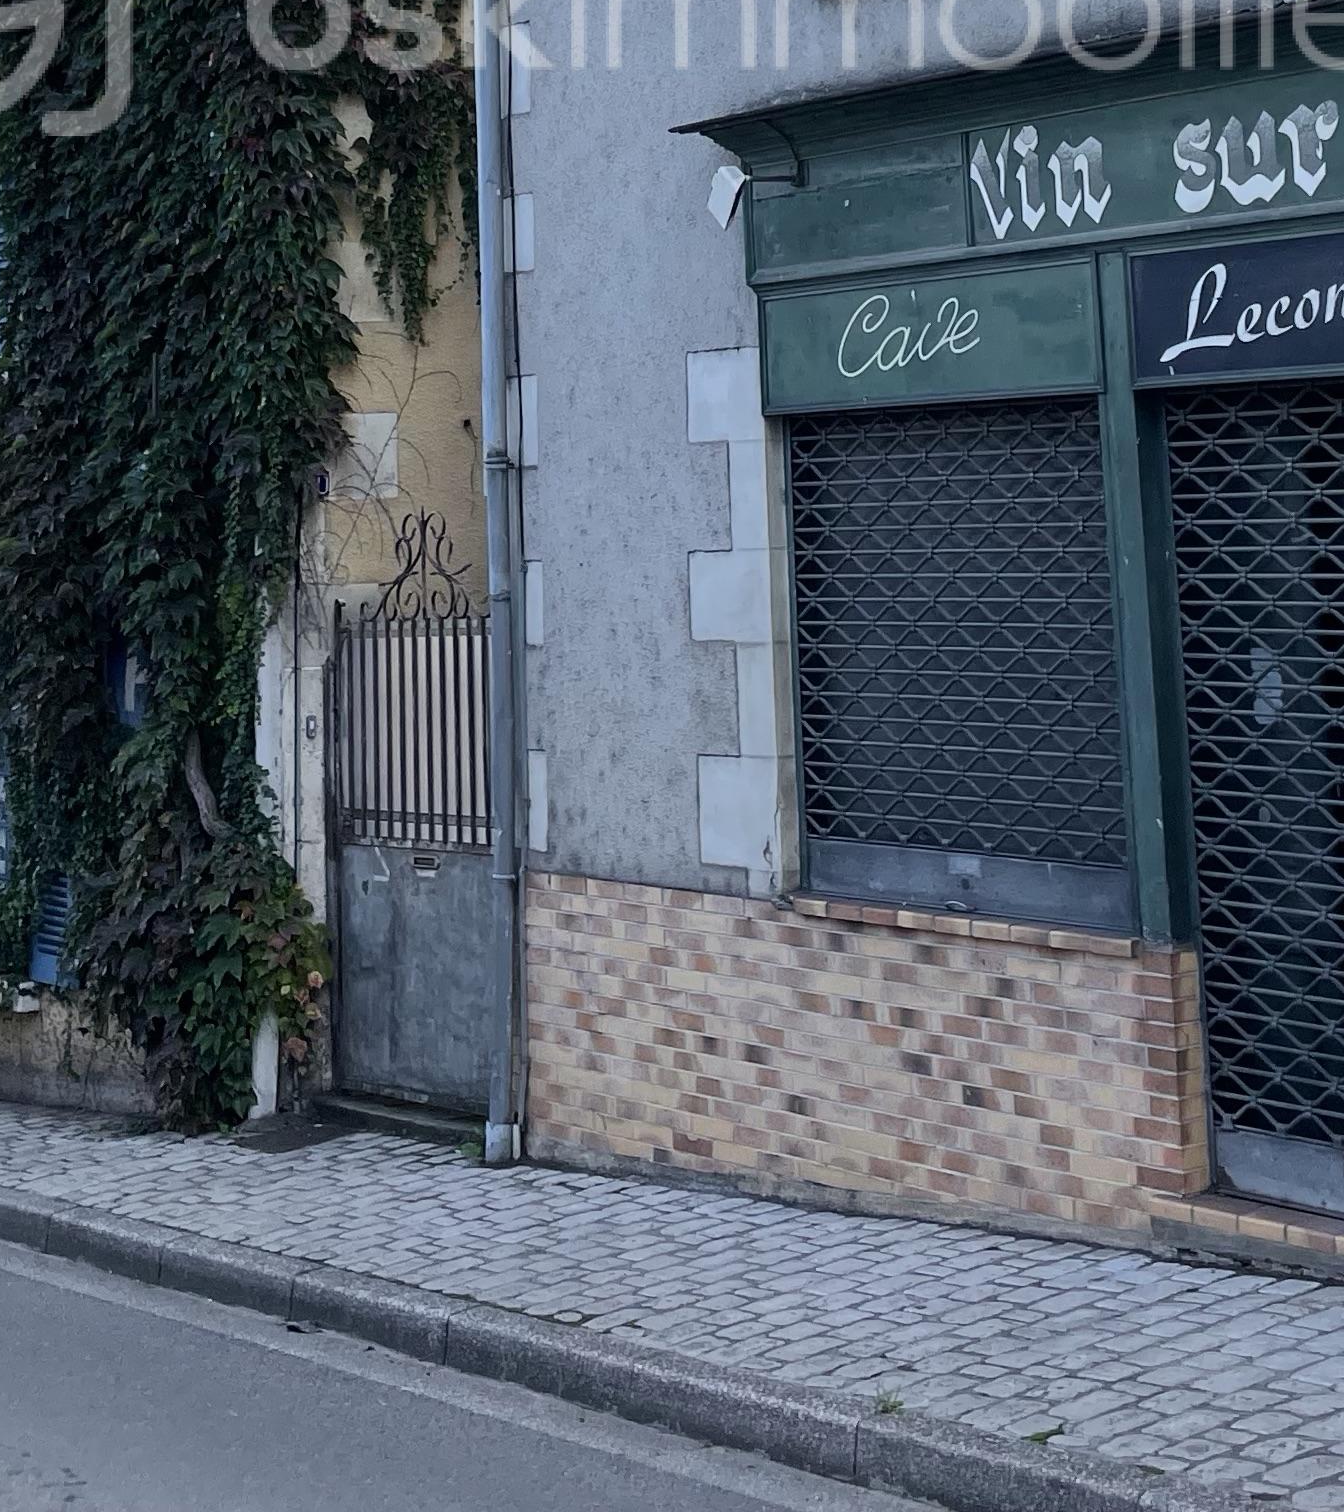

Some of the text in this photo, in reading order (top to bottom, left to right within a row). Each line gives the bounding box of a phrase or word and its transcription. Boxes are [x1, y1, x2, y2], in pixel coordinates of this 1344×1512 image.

[970, 124, 1112, 240] Vin
[1172, 99, 1339, 213] sur
[836, 291, 982, 379] Cave
